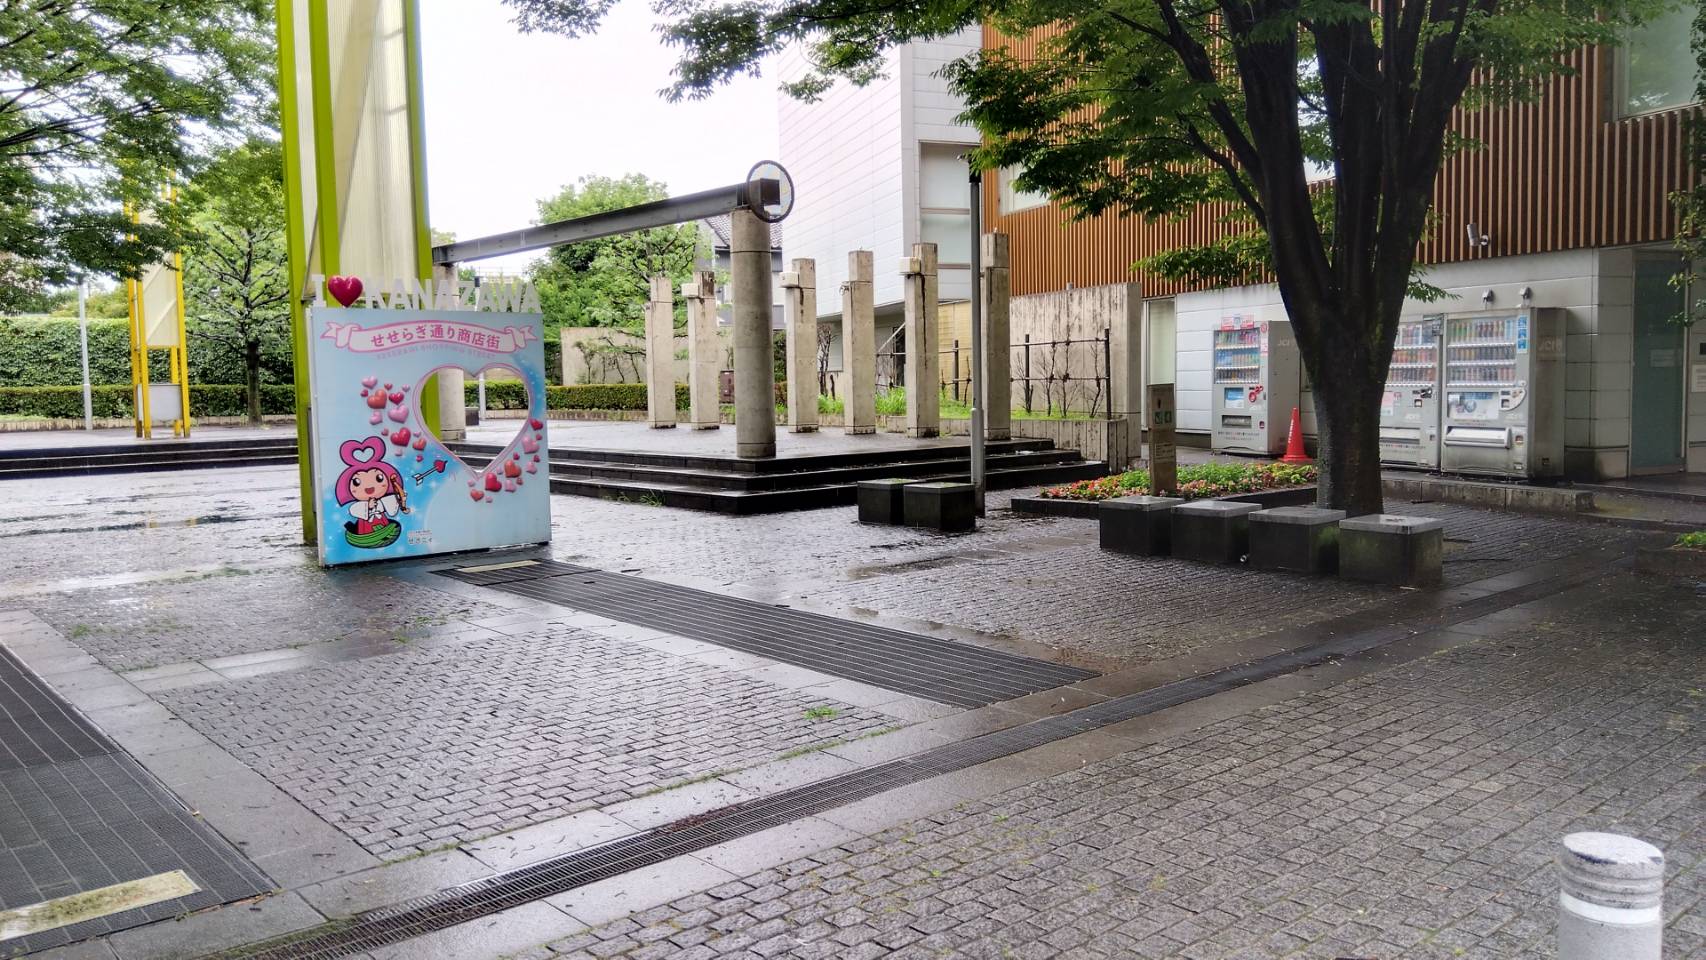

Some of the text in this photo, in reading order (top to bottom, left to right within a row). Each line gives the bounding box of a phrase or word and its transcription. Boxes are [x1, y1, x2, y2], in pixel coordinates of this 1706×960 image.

[311, 274, 542, 313] I KANAZAWA
[371, 324, 500, 349] せせらぎ通り商店街
